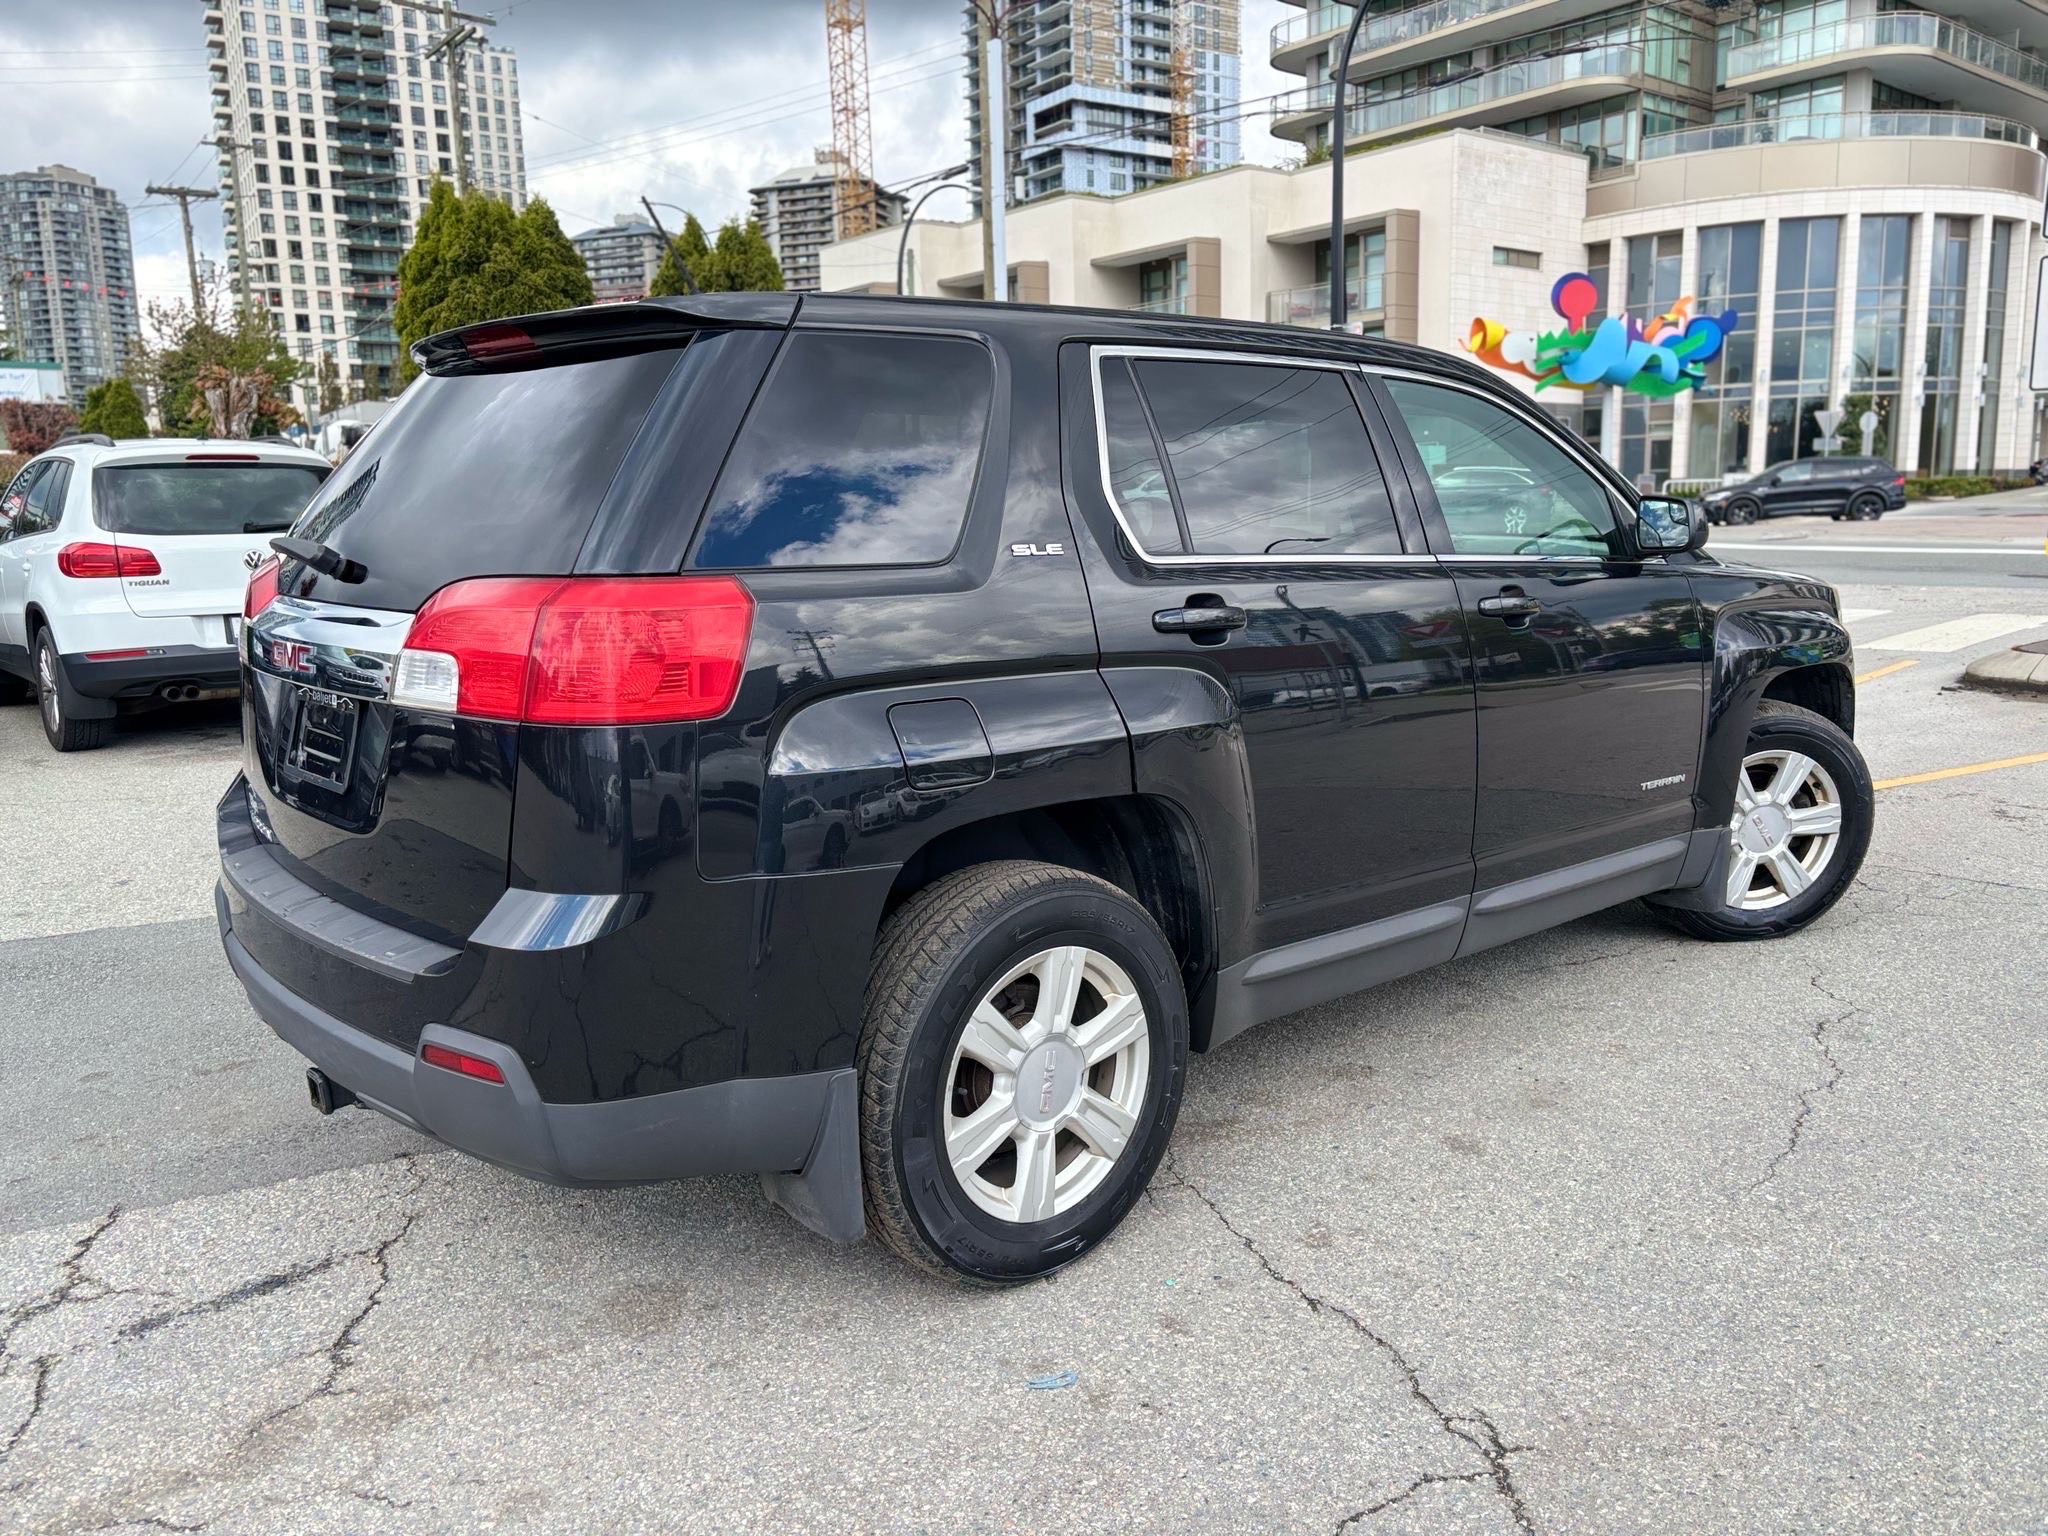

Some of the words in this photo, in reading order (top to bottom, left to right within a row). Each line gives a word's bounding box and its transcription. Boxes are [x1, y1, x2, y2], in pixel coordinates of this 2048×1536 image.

[1011, 543, 1065, 557] SLE
[127, 579, 170, 587] TIGUAN
[271, 640, 317, 673] GMC
[1640, 773, 1686, 791] TERRAIN
[1752, 814, 1774, 847] GMC
[1039, 1050, 1057, 1114] GMC
